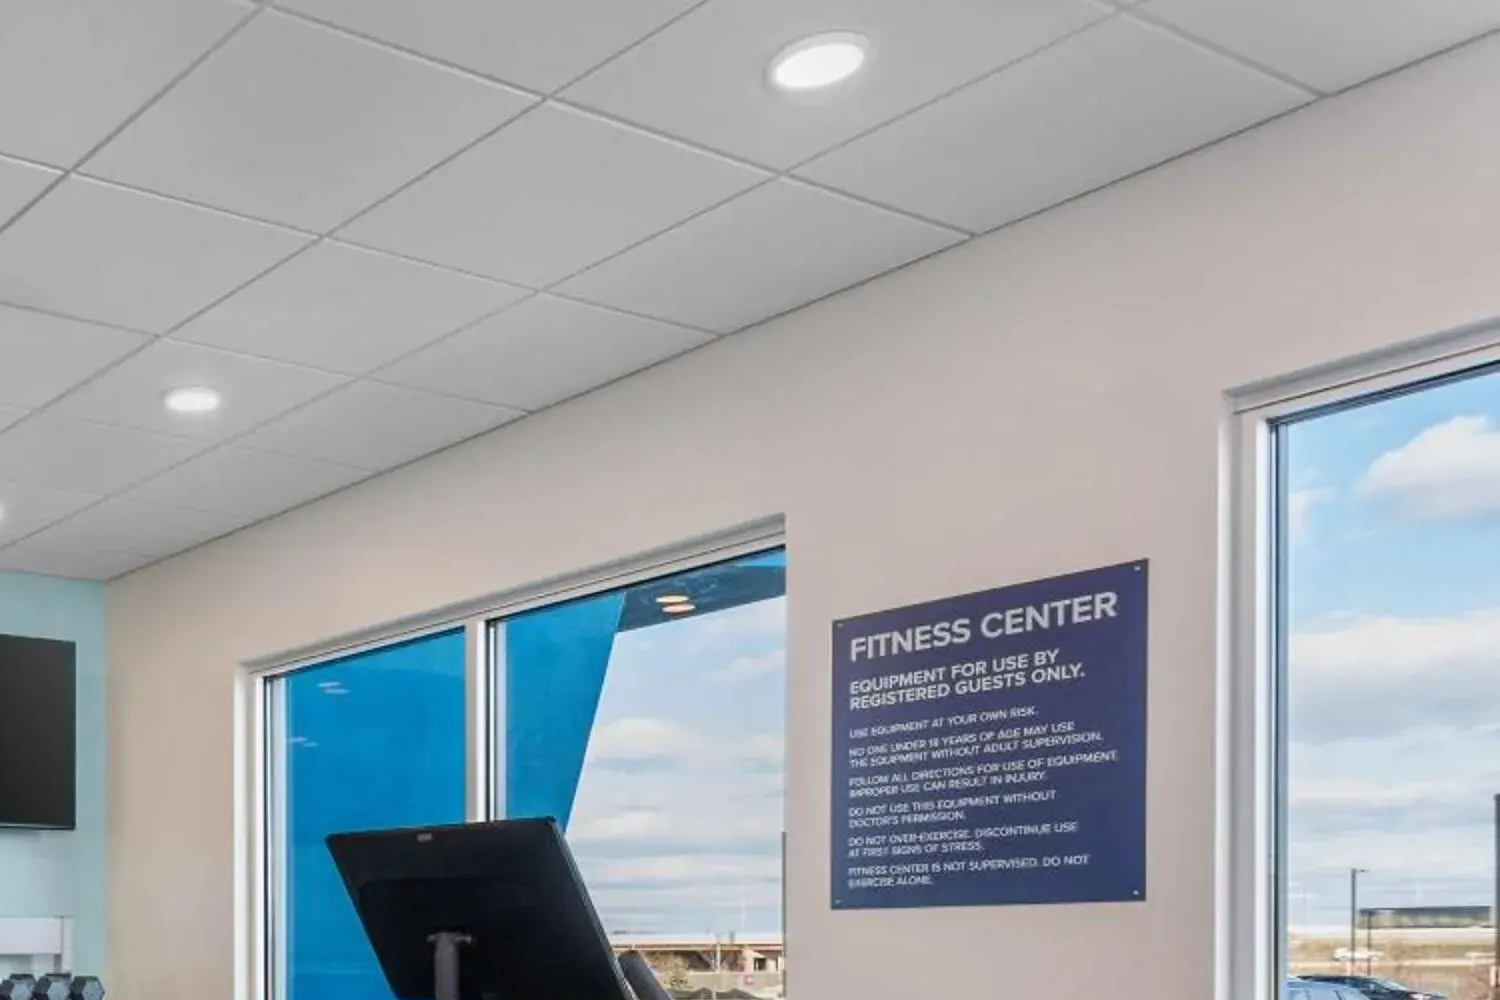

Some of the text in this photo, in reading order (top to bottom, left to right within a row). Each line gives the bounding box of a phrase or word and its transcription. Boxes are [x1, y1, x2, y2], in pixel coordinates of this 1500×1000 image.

[850, 591, 1118, 662] FITNESS CENTER
[849, 648, 1059, 695] EQUIPMENT FOR USE BY
[850, 662, 1086, 711] REGISTERED GUESTS ONLY.
[871, 720, 929, 736] EQUIPMENT
[931, 717, 944, 729] AT
[948, 713, 977, 726] YOUR
[980, 709, 1007, 722] OWN
[890, 739, 926, 753] UNDER
[941, 733, 977, 747] YEARS
[980, 731, 995, 742] OF
[1023, 723, 1049, 737] MAY
[1051, 720, 1075, 733] USE
[870, 751, 928, 767] EQUIPMENT
[931, 745, 980, 759] WITHOUT
[983, 740, 1019, 753] ADULT
[849, 775, 889, 788] FOLLOW
[891, 772, 908, 783] ALL
[911, 765, 975, 781] DIRECTIONS
[977, 762, 1000, 774] FOR
[1002, 759, 1025, 771] USE
[1027, 757, 1045, 769] OF
[849, 785, 899, 799] IMPROPER
[900, 783, 921, 793] USE
[923, 780, 947, 791] CAN
[989, 775, 1003, 784] IN
[849, 789, 1057, 818] DO NOT USE THIS EQUIPMENT WITHOUT
[866, 834, 887, 846] NOT
[974, 823, 1052, 838] DISCONTINUE
[1053, 821, 1078, 833] USE
[924, 843, 939, 853] OF
[848, 865, 888, 877] FITNESS
[889, 863, 930, 875] CENTER
[931, 862, 941, 873] IS
[943, 861, 966, 872] NOT
[1042, 856, 1061, 868] DO
[1063, 854, 1089, 866] NOT
